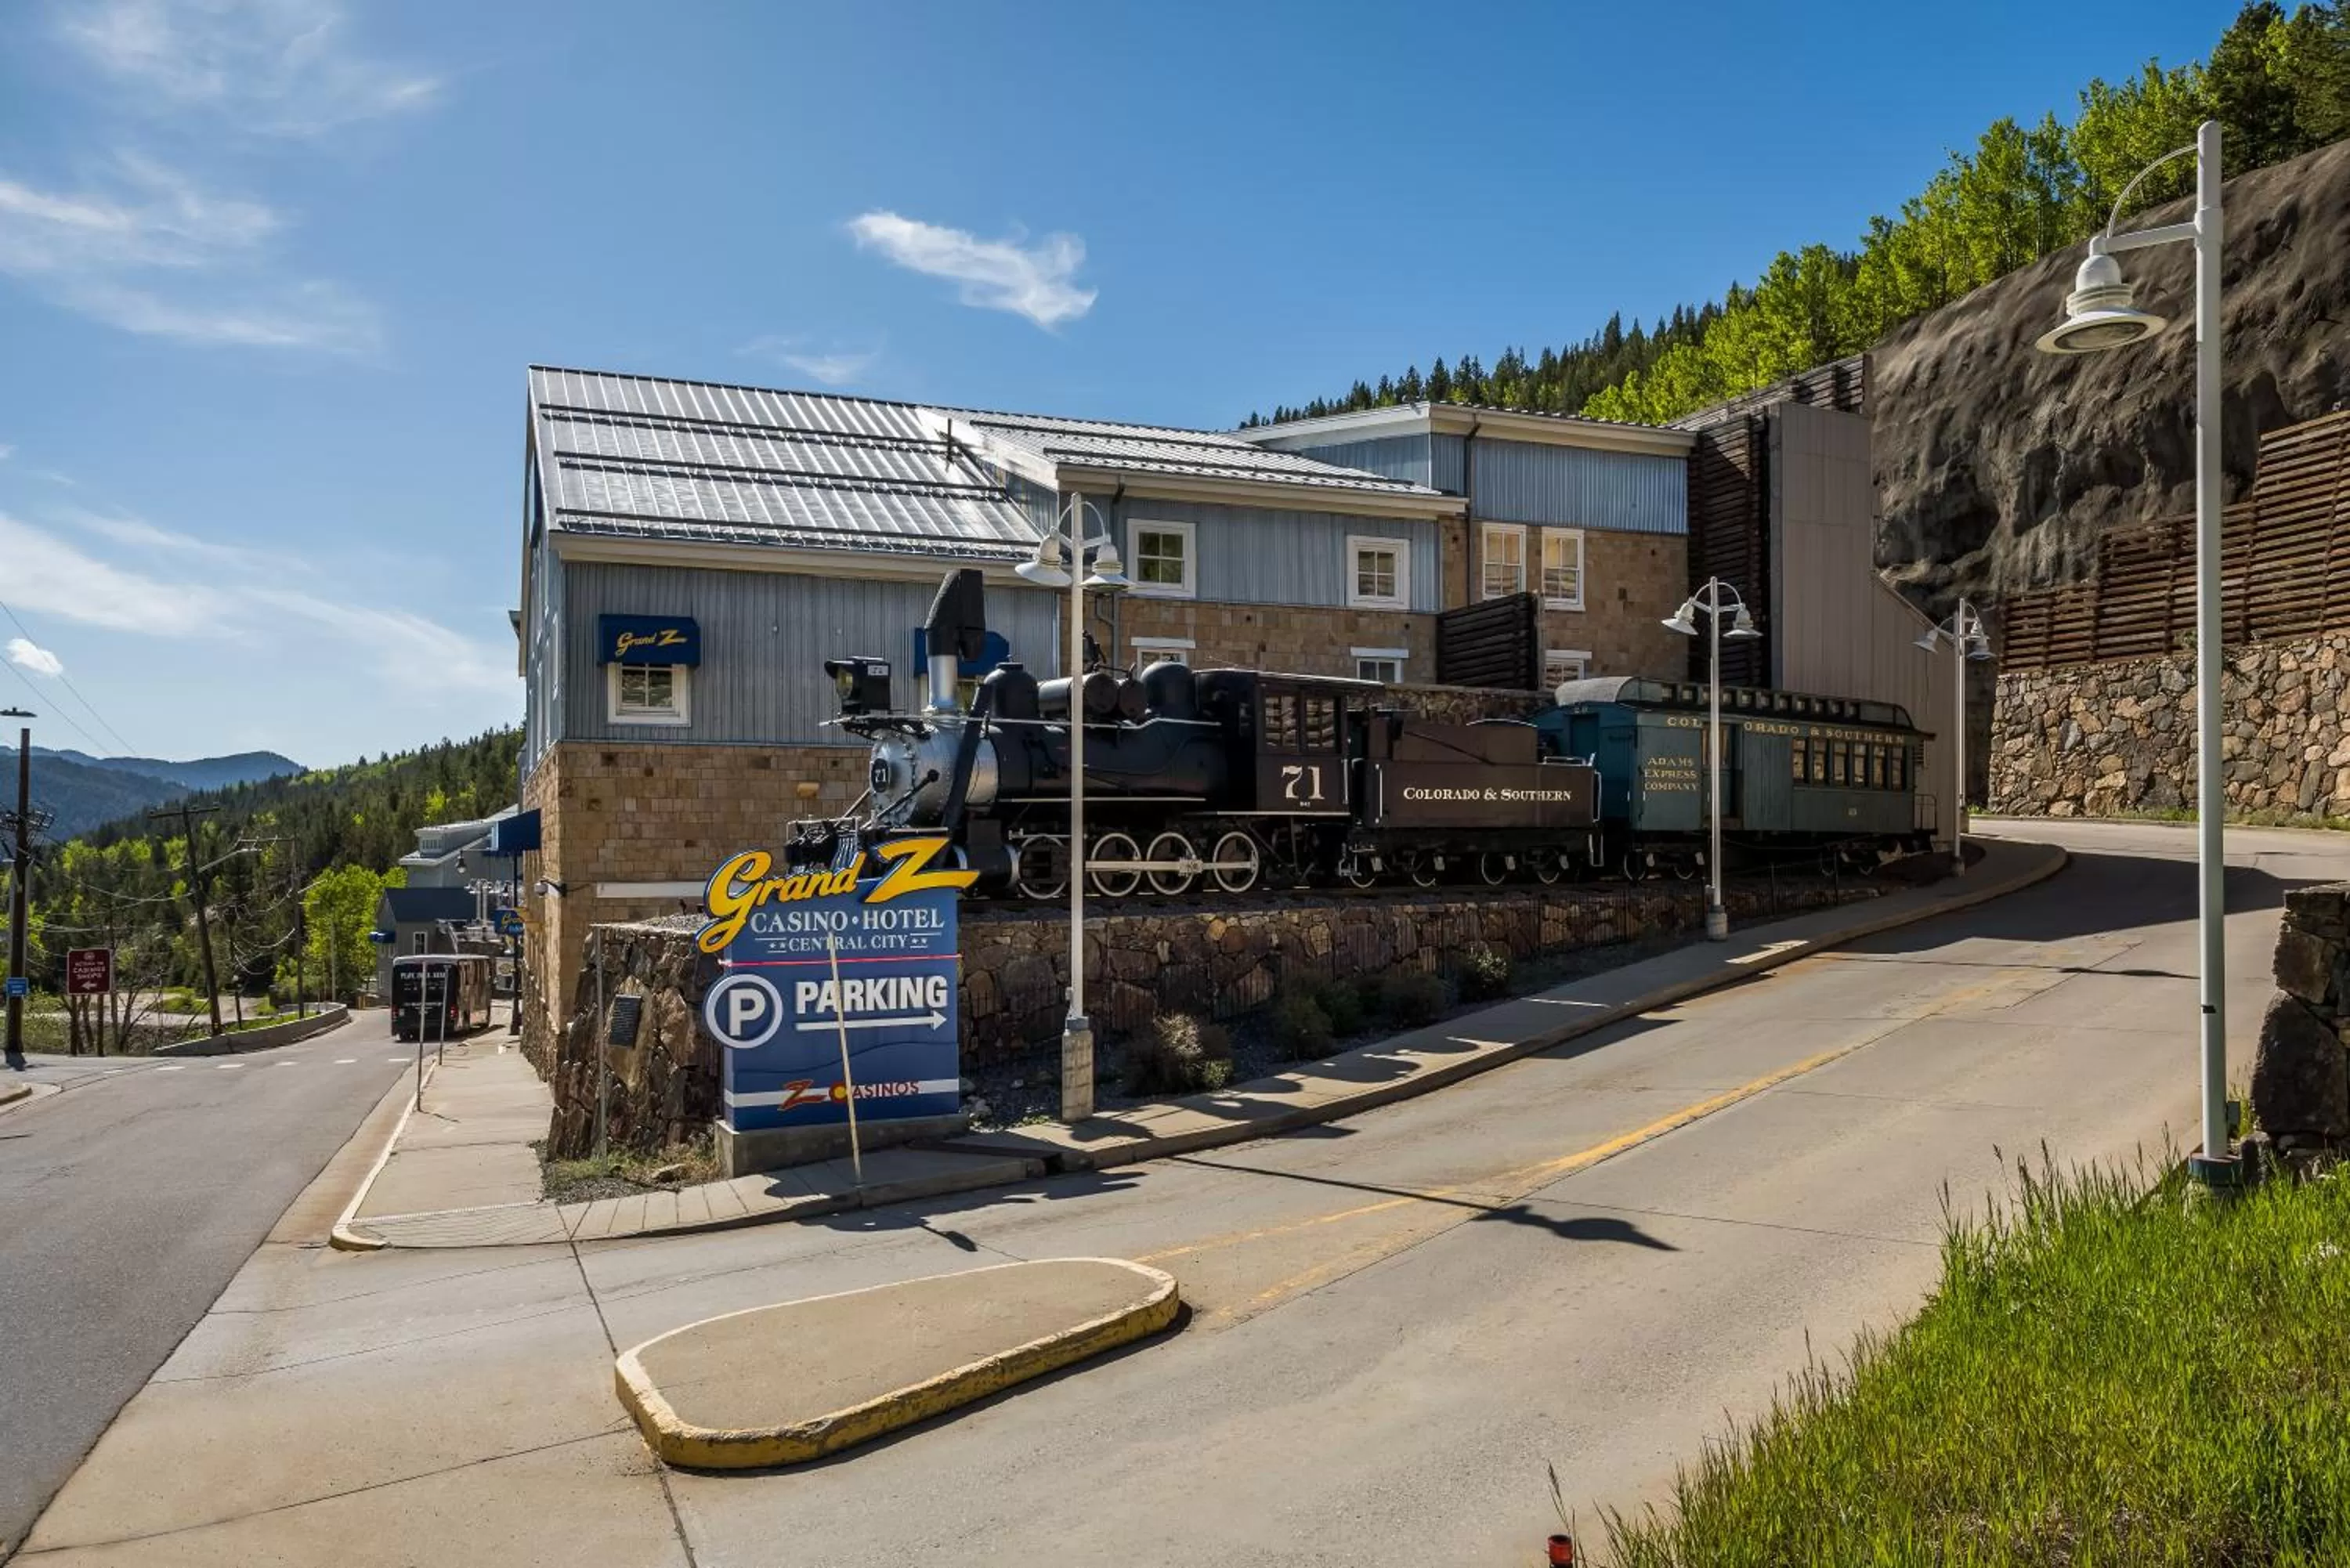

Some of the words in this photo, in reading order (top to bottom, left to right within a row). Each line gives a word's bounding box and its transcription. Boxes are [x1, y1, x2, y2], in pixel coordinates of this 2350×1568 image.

[615, 632, 656, 656] Grand
[657, 629, 688, 646] Z
[1810, 726, 1820, 736] &
[1826, 728, 1904, 744] SOUTHERN
[1647, 757, 1694, 767] ADAMS
[874, 768, 886, 783] 71
[1282, 765, 1325, 800] 71
[1644, 769, 1697, 779] EXPRESS
[1403, 787, 1480, 800] COLORADO
[1484, 787, 1498, 800] &
[1500, 788, 1571, 802] SOUTHERN
[1644, 782, 1697, 791] COMPANY
[696, 850, 866, 953] Grand
[865, 836, 981, 904] Z
[750, 910, 848, 934] CASINO
[862, 908, 945, 930] HOTEL
[788, 935, 867, 952] CENTRAL
[870, 934, 909, 949] CITY
[795, 975, 948, 1014] PARKING
[728, 988, 766, 1036] P
[777, 1078, 826, 1111] Z
[829, 1081, 919, 1104] CASINOS
